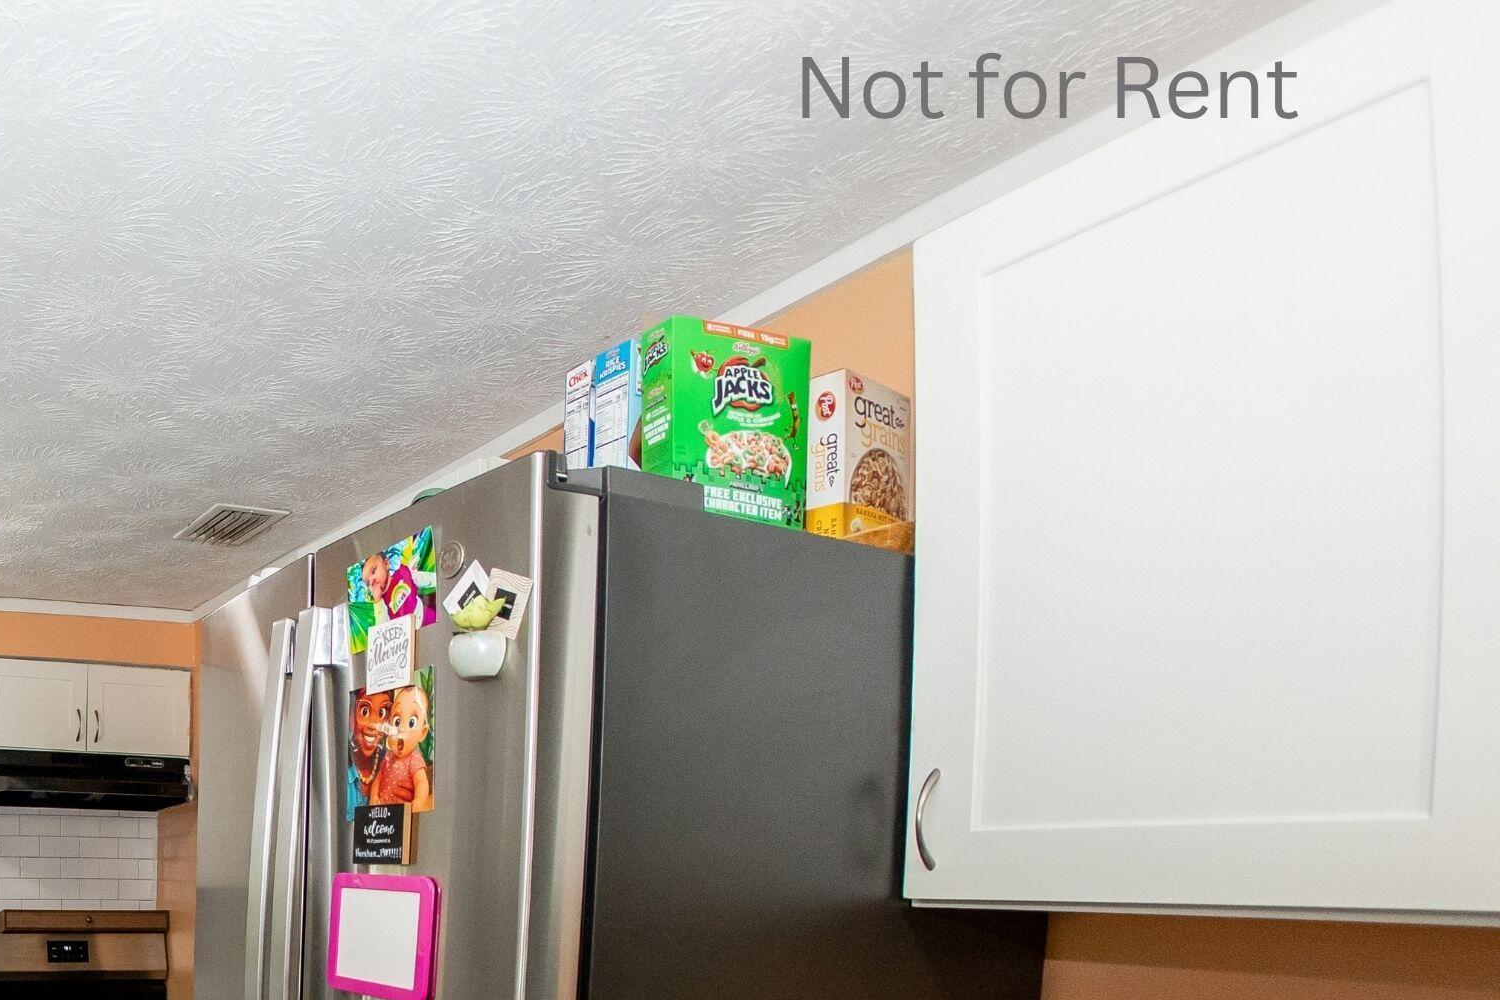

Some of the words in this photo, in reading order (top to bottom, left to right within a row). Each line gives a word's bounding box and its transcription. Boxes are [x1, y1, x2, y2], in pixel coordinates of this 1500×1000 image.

[600, 361, 627, 381] KRISPIES
[604, 356, 620, 369] RICE
[644, 345, 667, 372] JACKS
[568, 369, 589, 388] Chex
[724, 367, 760, 380] APPLE
[714, 376, 771, 409] JACKS
[819, 393, 835, 418] Post
[854, 396, 896, 429] great
[861, 419, 906, 455] grains
[811, 444, 826, 493] grains
[820, 433, 838, 479] great
[704, 485, 731, 500] FREE
[733, 490, 783, 510] EXCLUSIVE
[704, 496, 759, 517] CHARACTER
[760, 507, 782, 521] ITEM
[383, 626, 404, 646] KEEP
[368, 637, 409, 671] Moving
[371, 806, 388, 819] HELLO
[363, 820, 395, 837] welcome
